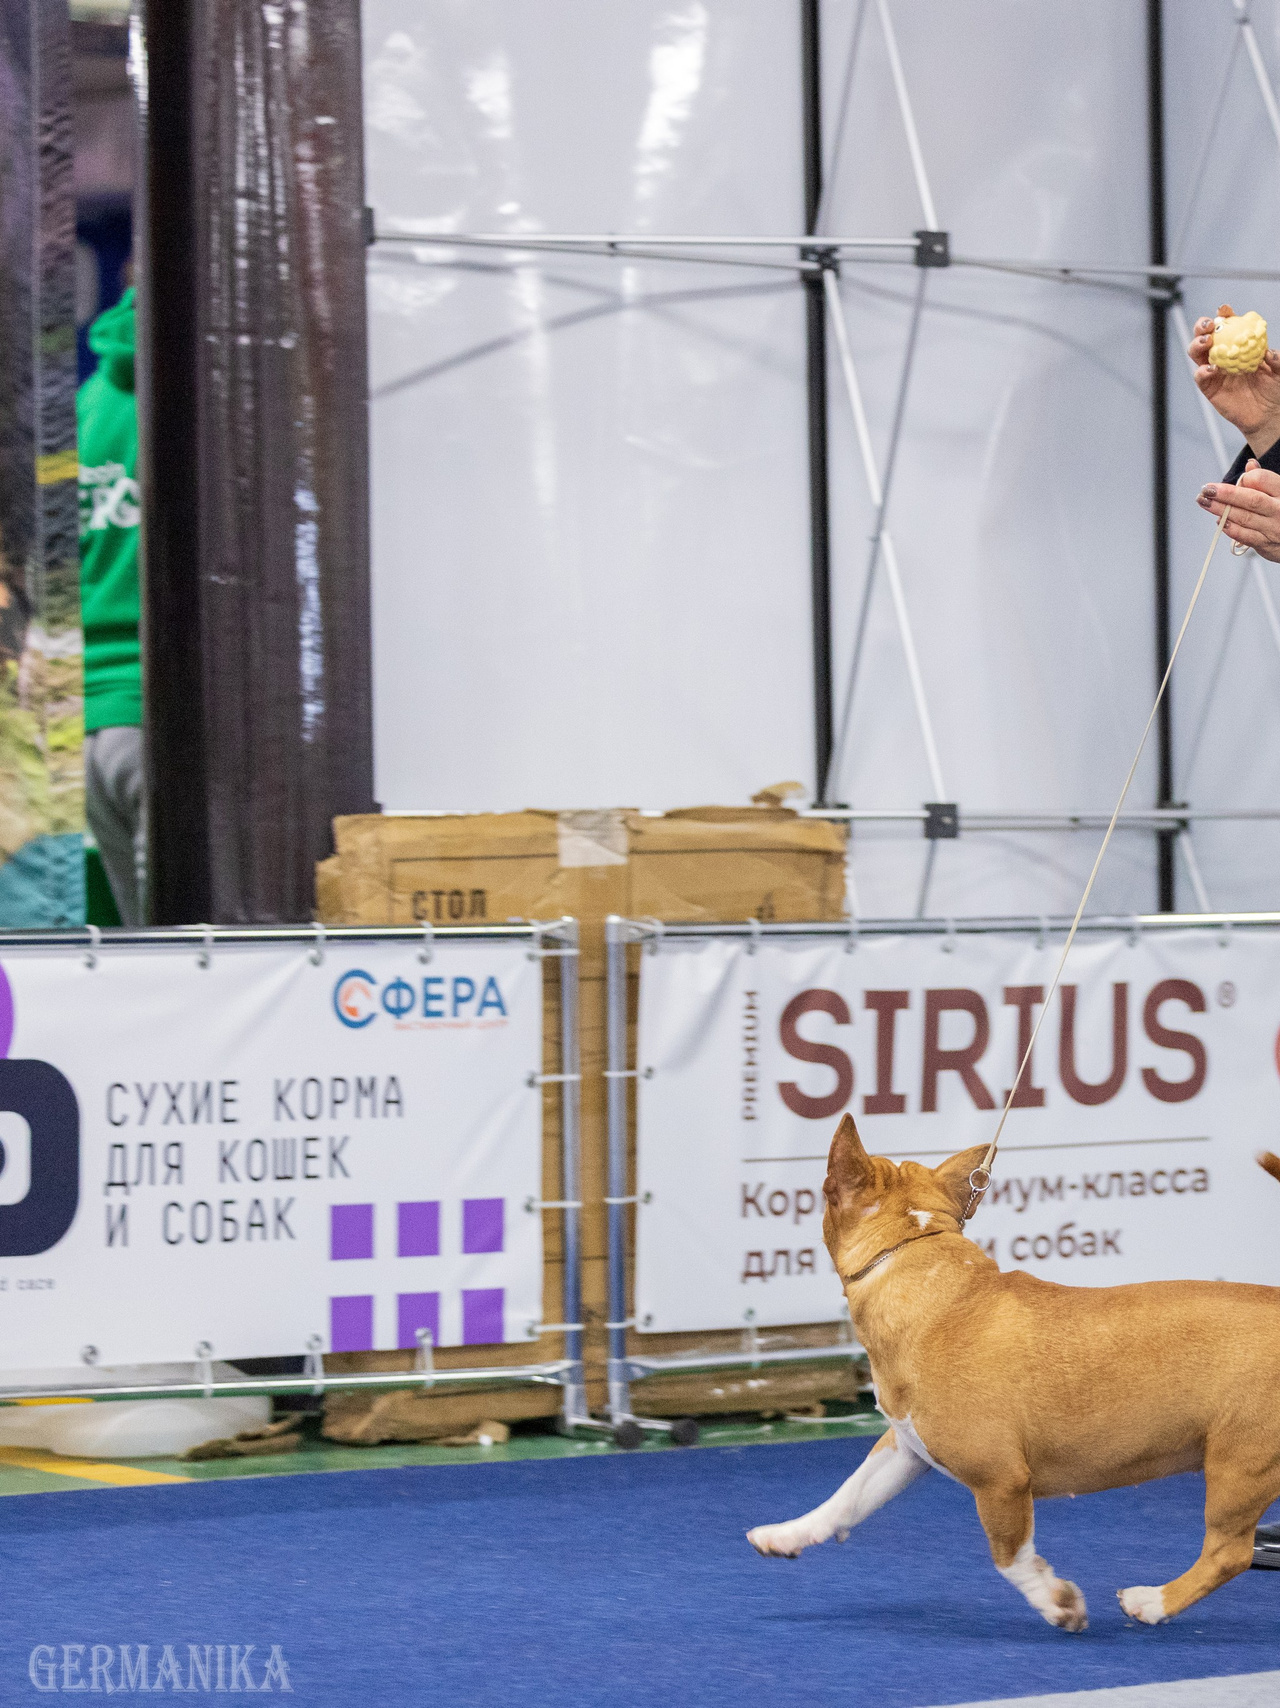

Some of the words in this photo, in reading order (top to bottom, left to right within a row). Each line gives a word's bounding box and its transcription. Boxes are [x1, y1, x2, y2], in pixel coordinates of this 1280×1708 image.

[412, 889, 486, 920] СТОЛ
[333, 969, 508, 1029] СФЕРА
[106, 1080, 240, 1127] СУХИЕ
[273, 1076, 404, 1121] КОРМА
[103, 1142, 184, 1196] ДЛЯ
[218, 1136, 350, 1183] КОШЕК
[106, 1204, 128, 1247] И
[163, 1198, 296, 1245] СОБАК
[741, 1247, 816, 1284] для
[1010, 1222, 1122, 1260] собак
